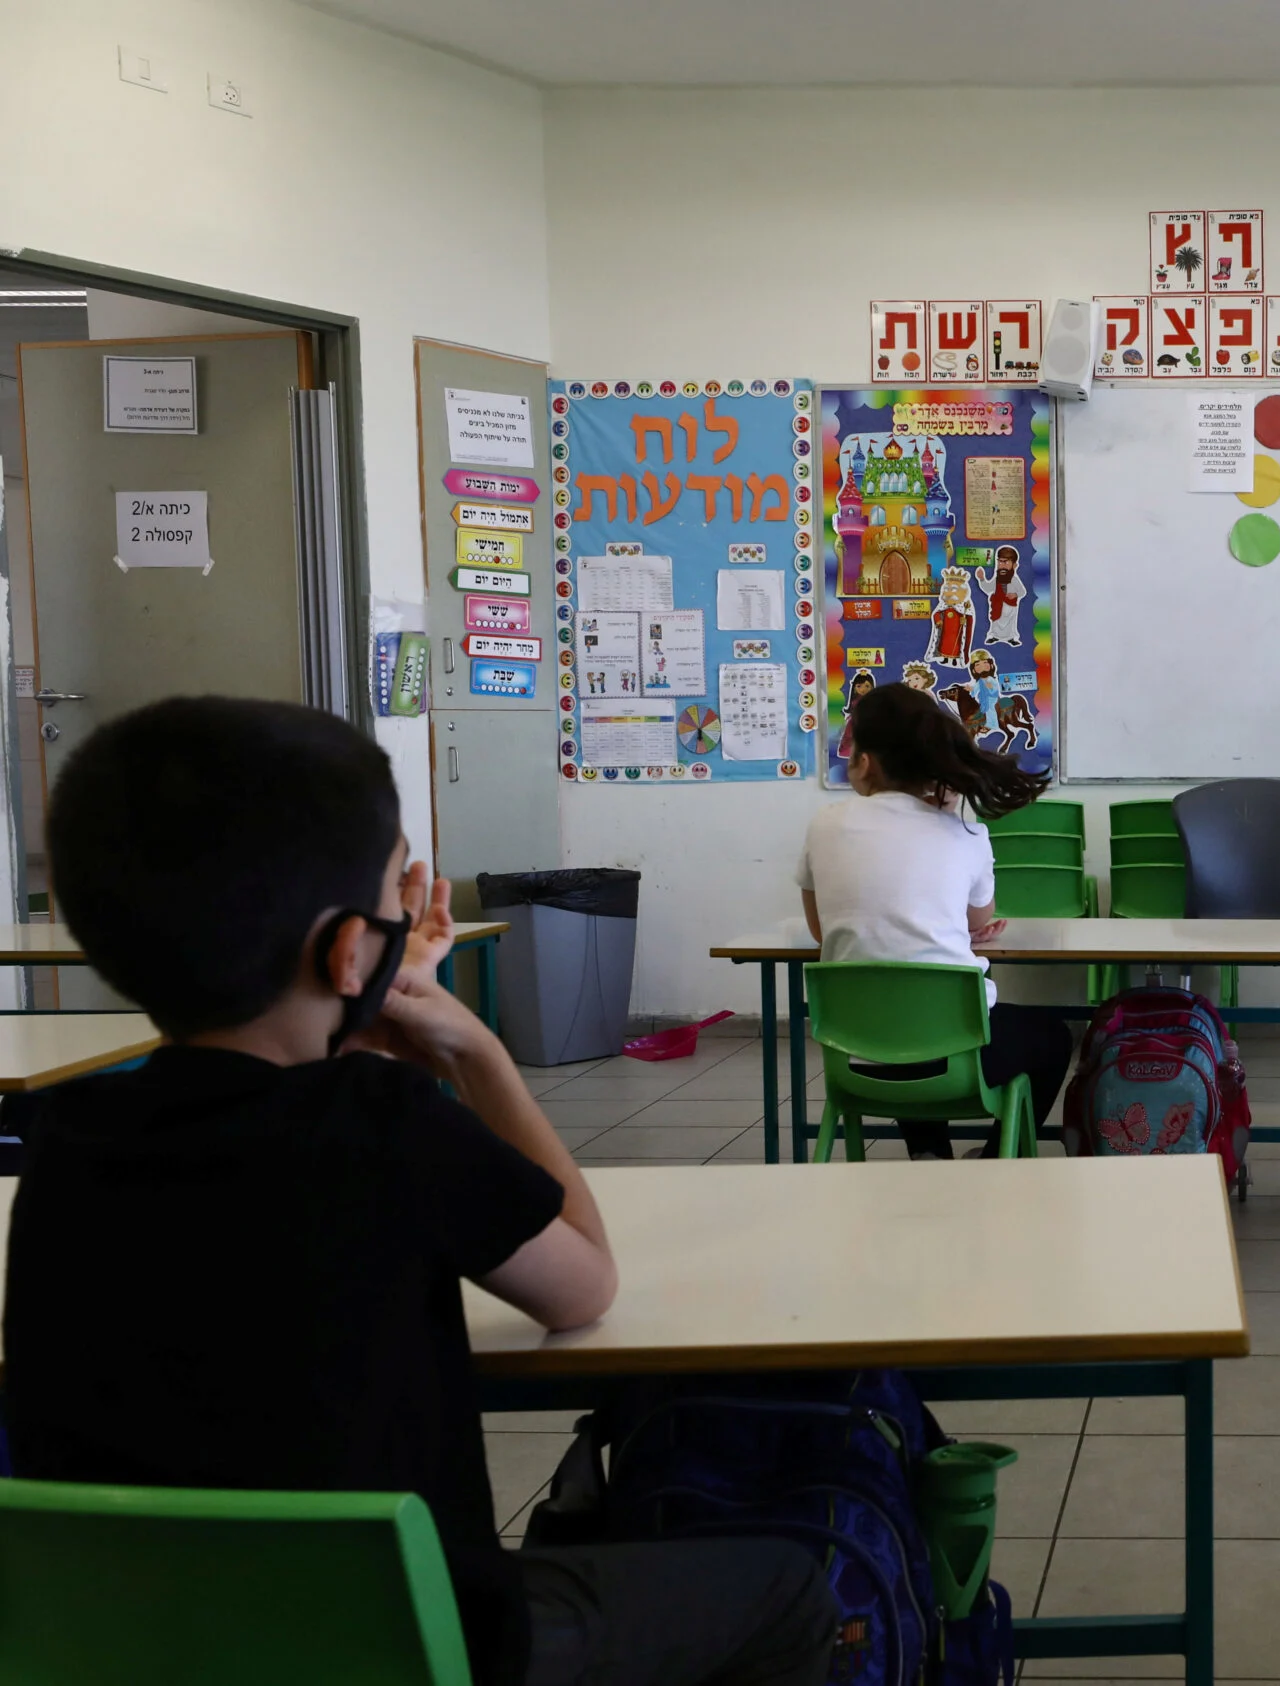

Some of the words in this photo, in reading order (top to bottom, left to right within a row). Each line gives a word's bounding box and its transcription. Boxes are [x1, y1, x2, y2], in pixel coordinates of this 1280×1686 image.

[1166, 224, 1191, 265] ץ
[1219, 223, 1251, 268] ף
[880, 312, 917, 349] ת
[938, 312, 977, 349] ש
[999, 312, 1029, 349] ר
[1107, 308, 1139, 350] ק
[1164, 308, 1195, 345] צ
[1220, 309, 1252, 346] פ
[630, 398, 740, 465] לוח
[159, 503, 191, 516] כיתה
[573, 471, 791, 526] מודעות
[131, 528, 140, 542] 2
[145, 528, 193, 544] קפסולה
